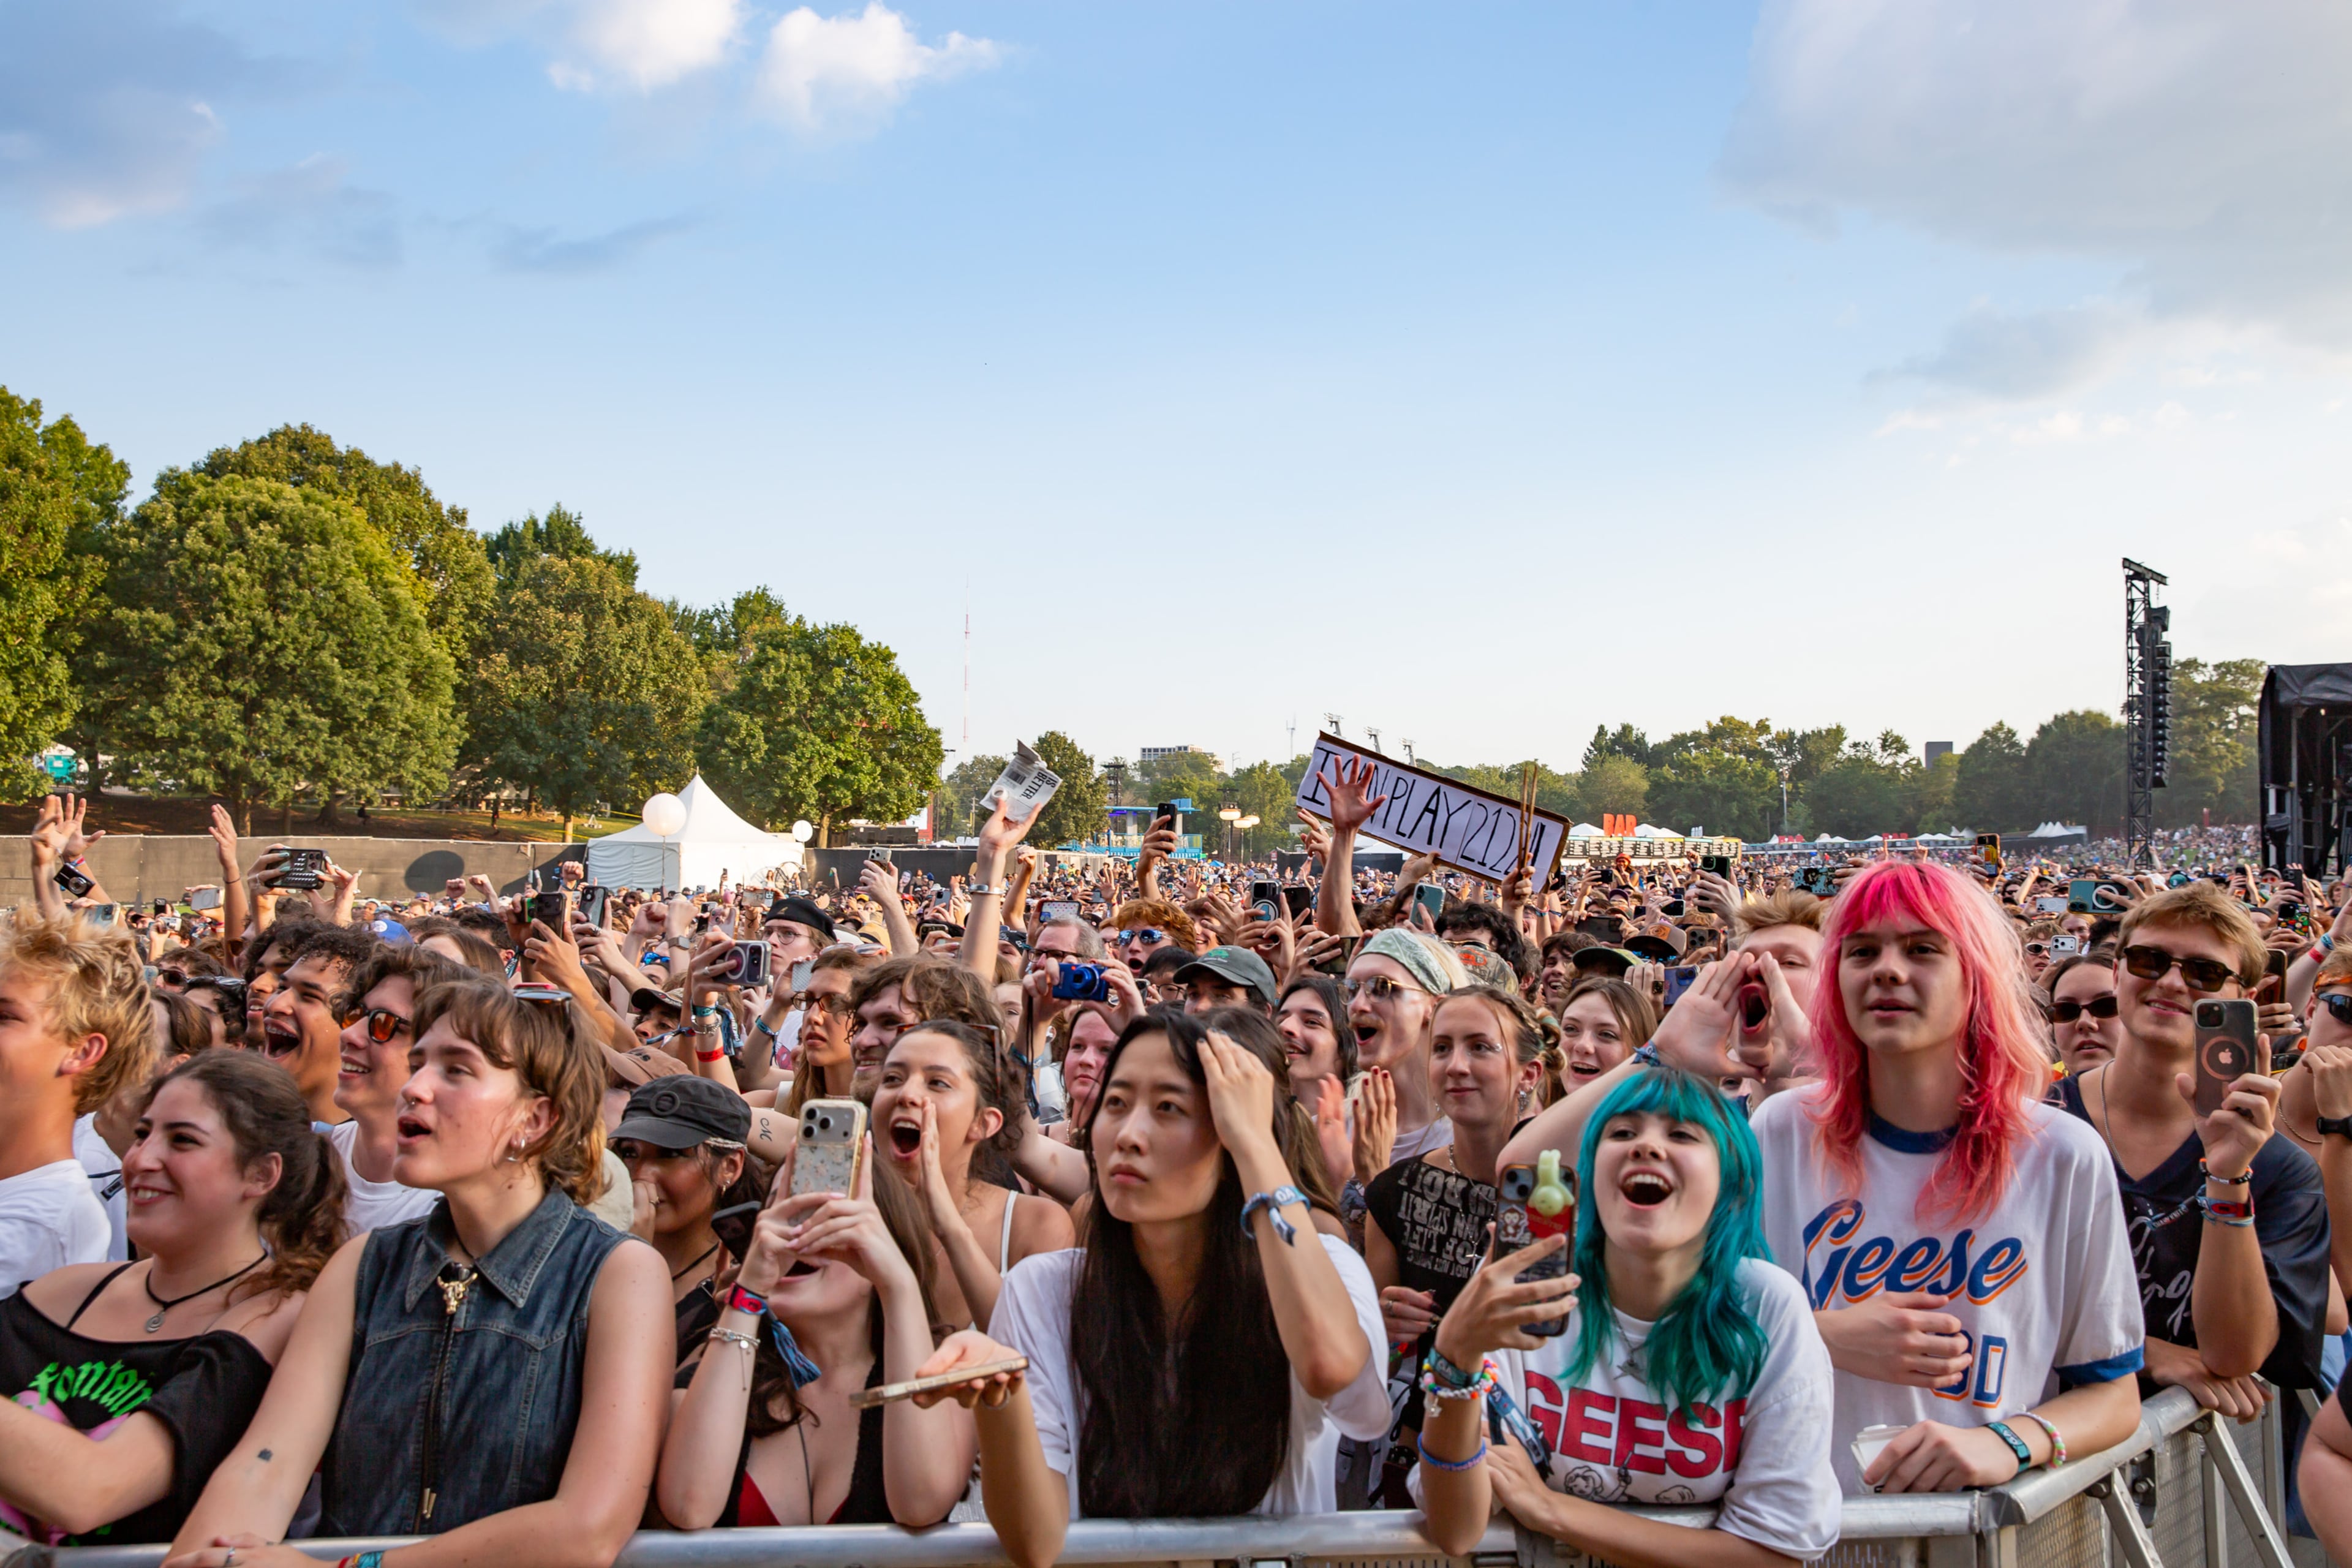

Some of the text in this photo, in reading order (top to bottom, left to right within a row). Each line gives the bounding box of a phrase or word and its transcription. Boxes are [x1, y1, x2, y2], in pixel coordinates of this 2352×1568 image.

[1046, 777, 1058, 788] IS
[1302, 746, 1341, 807] I
[1382, 775, 1472, 849] PLAY
[1603, 813, 1637, 837] BAR
[1801, 1199, 2028, 1311] Geese
